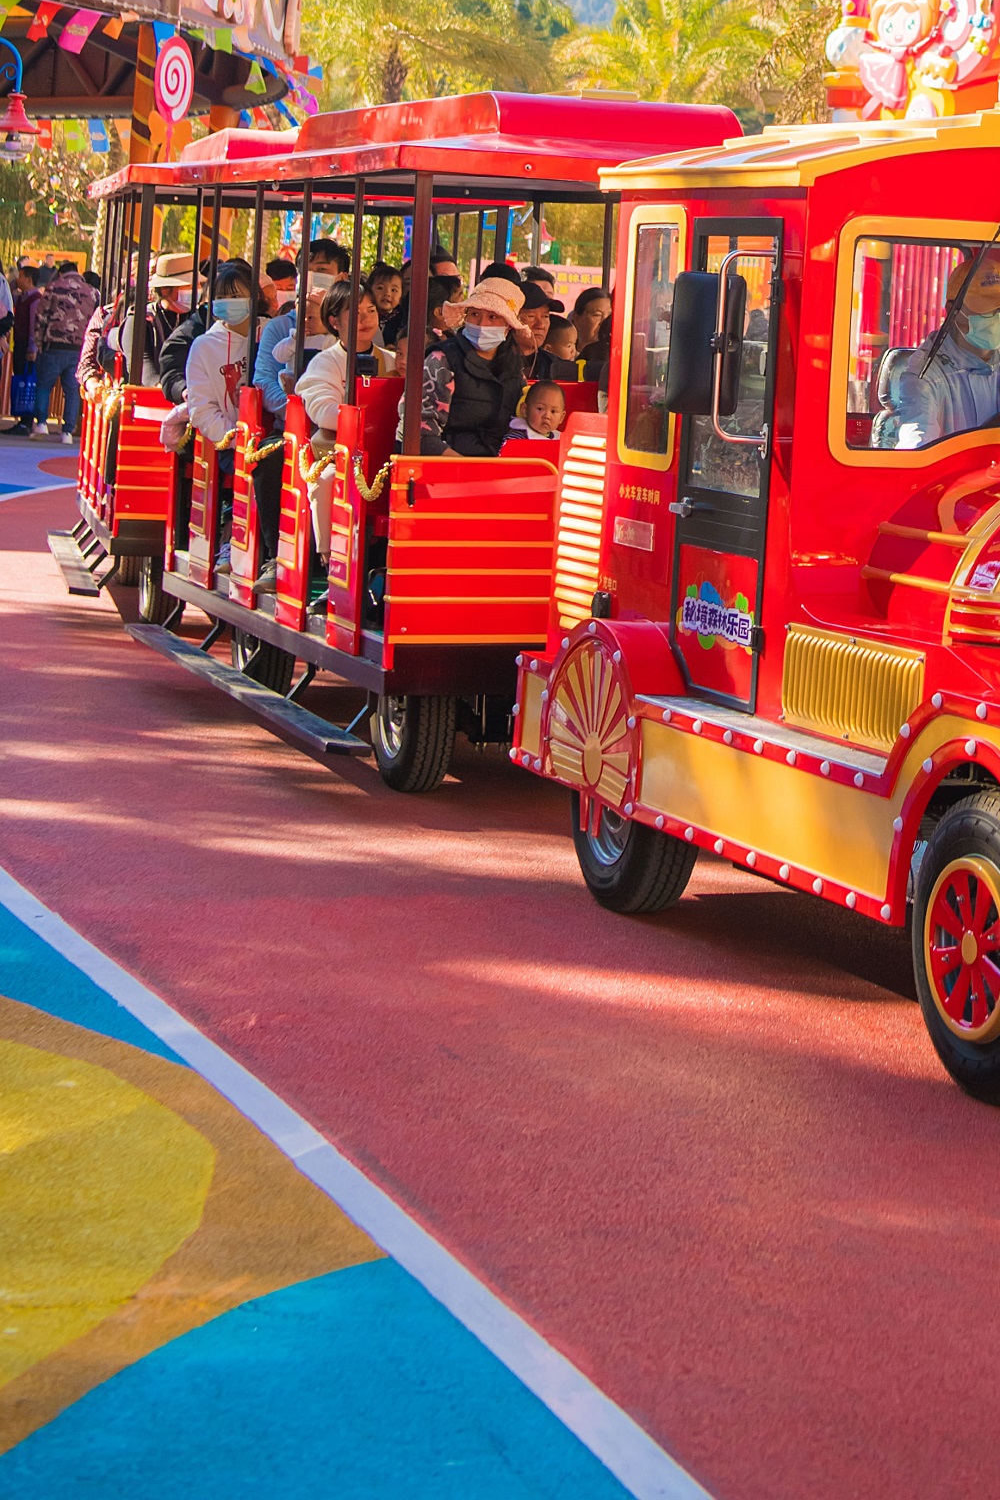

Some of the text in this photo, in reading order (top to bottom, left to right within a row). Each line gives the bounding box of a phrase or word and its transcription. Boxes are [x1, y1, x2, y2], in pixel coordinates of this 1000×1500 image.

[618, 483, 661, 505] 小火车发车时间
[685, 600, 750, 640] 秘境森林乐园
